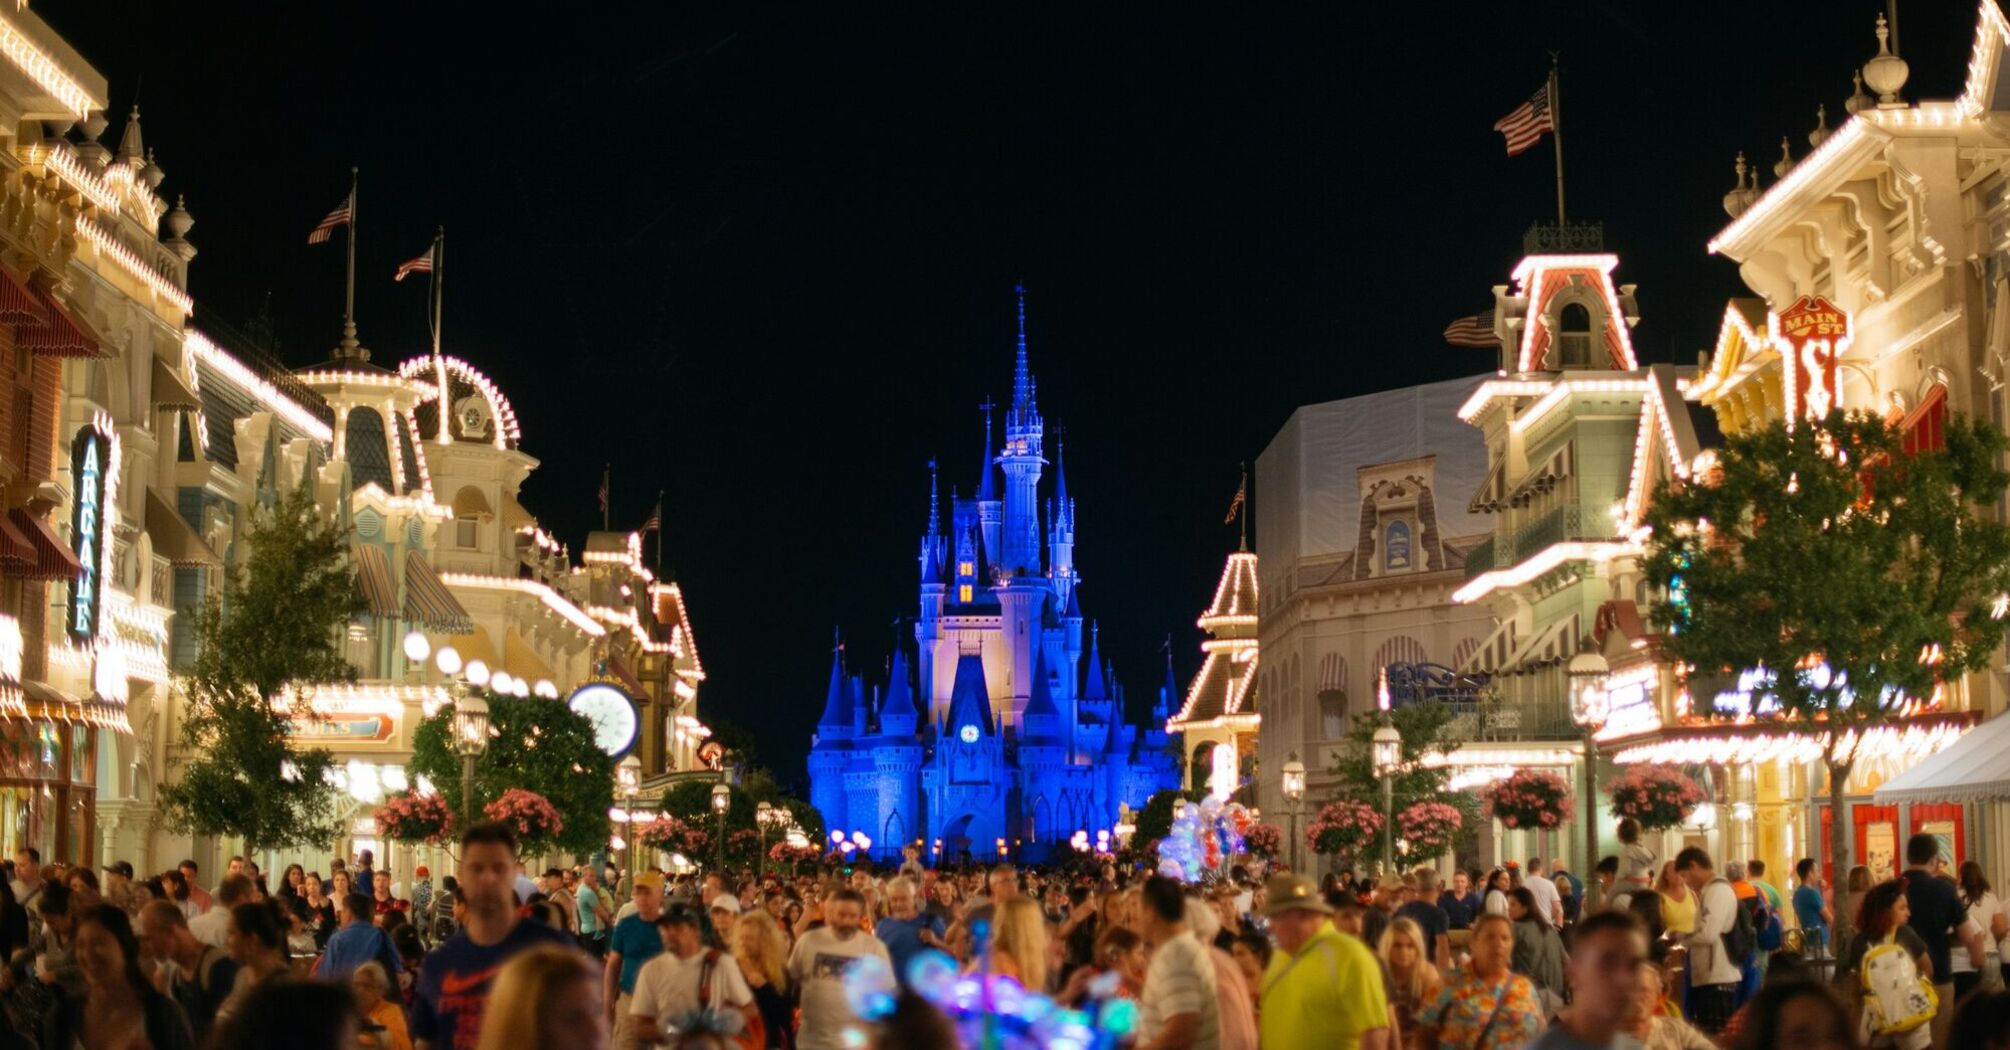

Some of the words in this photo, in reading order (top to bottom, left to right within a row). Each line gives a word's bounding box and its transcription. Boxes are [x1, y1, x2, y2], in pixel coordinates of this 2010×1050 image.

[1785, 312, 1838, 331] MAIN
[1817, 323, 1845, 335] ST.
[74, 434, 98, 636] ARCADE
